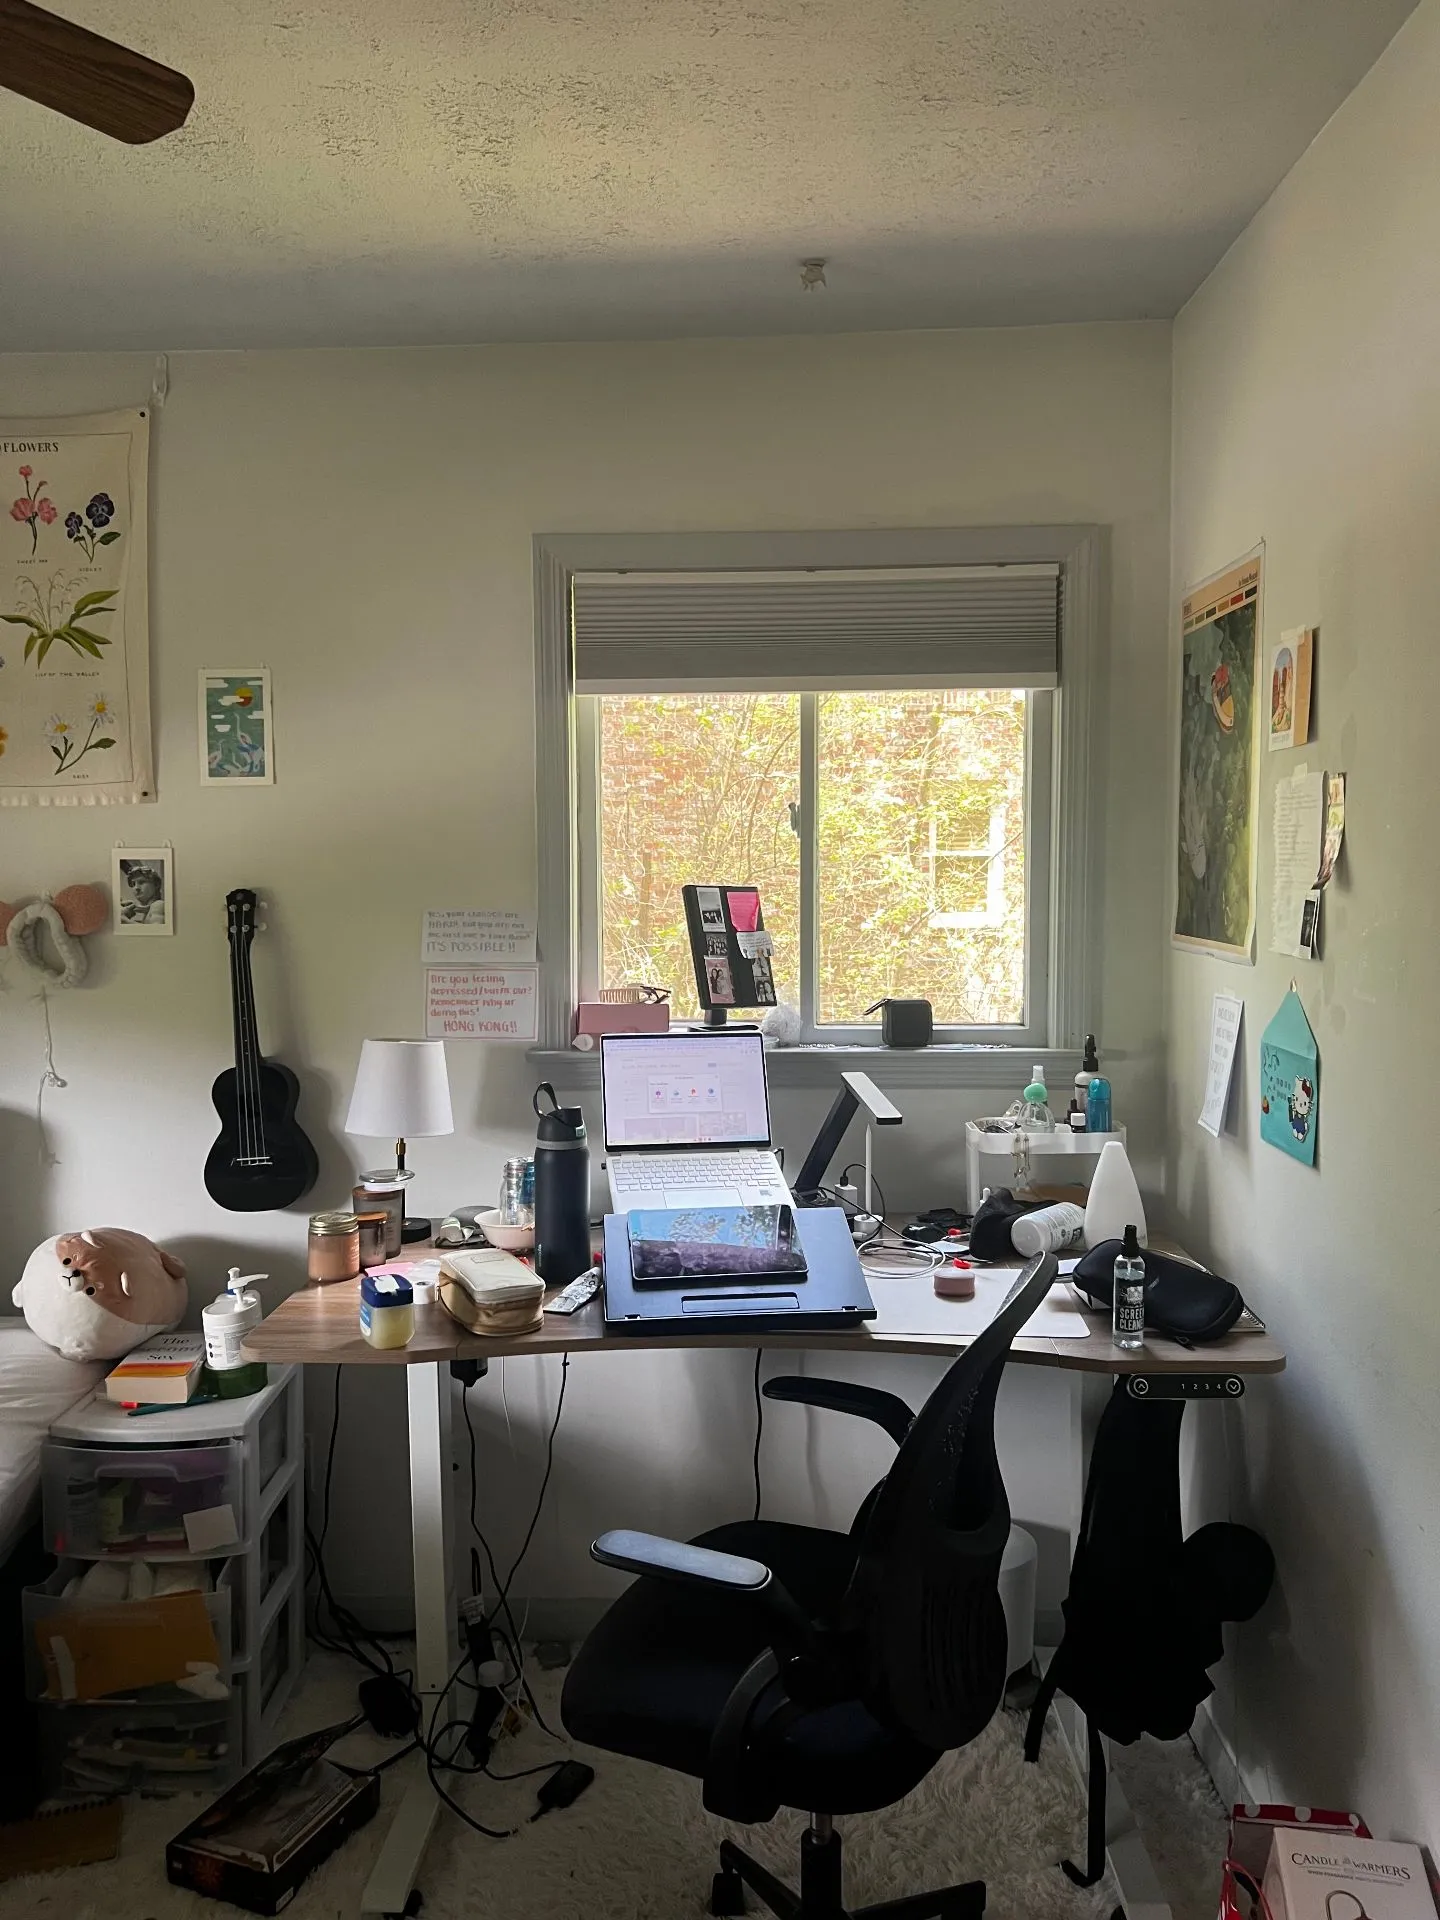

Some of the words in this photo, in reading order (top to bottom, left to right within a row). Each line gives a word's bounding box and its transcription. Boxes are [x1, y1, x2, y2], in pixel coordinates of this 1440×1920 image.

[0, 442, 59, 453] FLOWERS
[431, 974, 448, 984] Are
[449, 975, 469, 987] you
[472, 974, 505, 986] feeling
[482, 998, 502, 1009] why
[430, 1009, 457, 1019] doing
[443, 1020, 475, 1033] HONG
[1119, 1318, 1144, 1331] CLEANE
[1291, 1852, 1340, 1866] CANDLE
[1352, 1860, 1411, 1880] WARMERS
